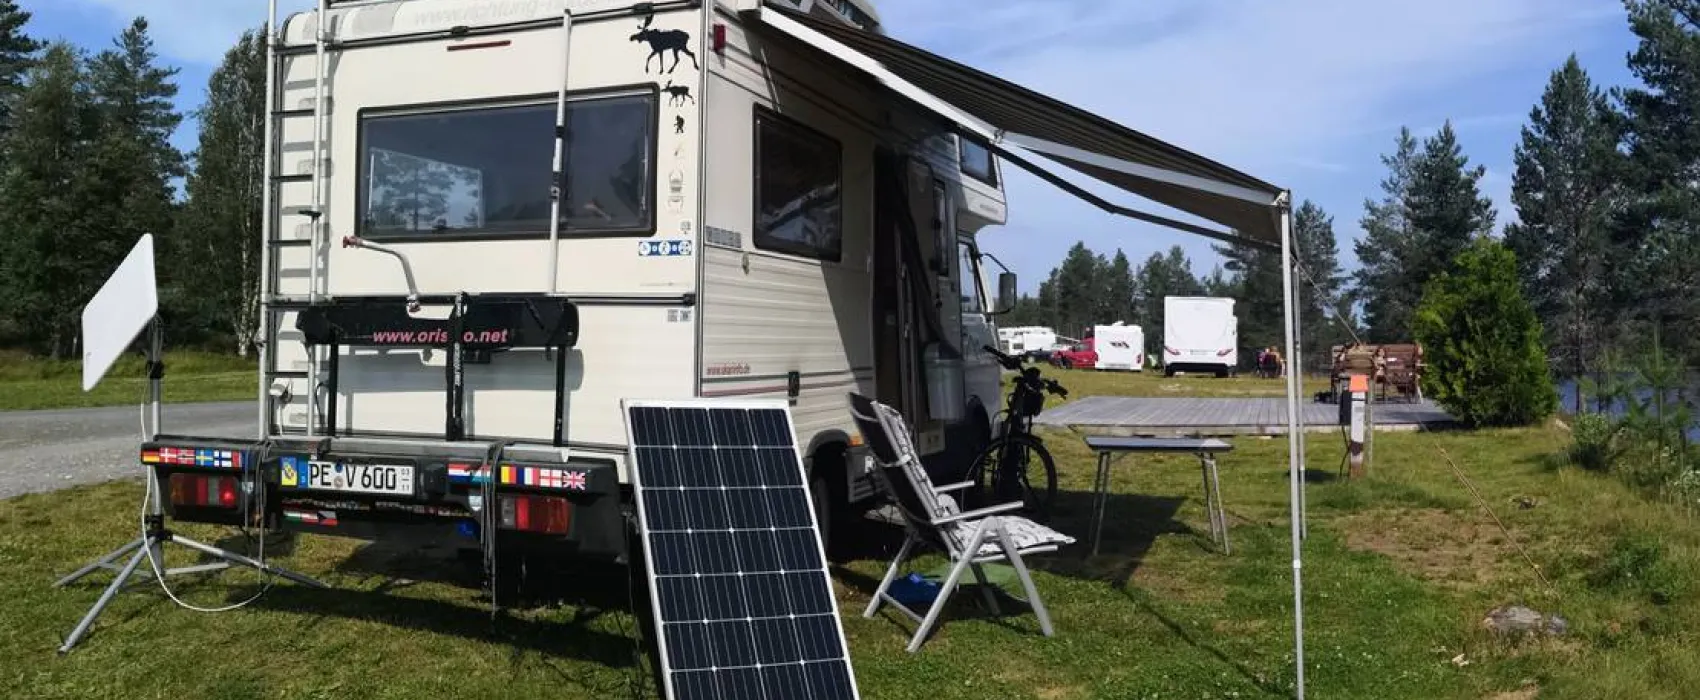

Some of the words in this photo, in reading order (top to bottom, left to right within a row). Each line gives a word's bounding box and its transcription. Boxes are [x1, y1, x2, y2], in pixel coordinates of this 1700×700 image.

[373, 328, 507, 343] www.oriso.net
[309, 463, 332, 485] PE
[345, 463, 357, 488] V
[361, 466, 396, 490] 600
